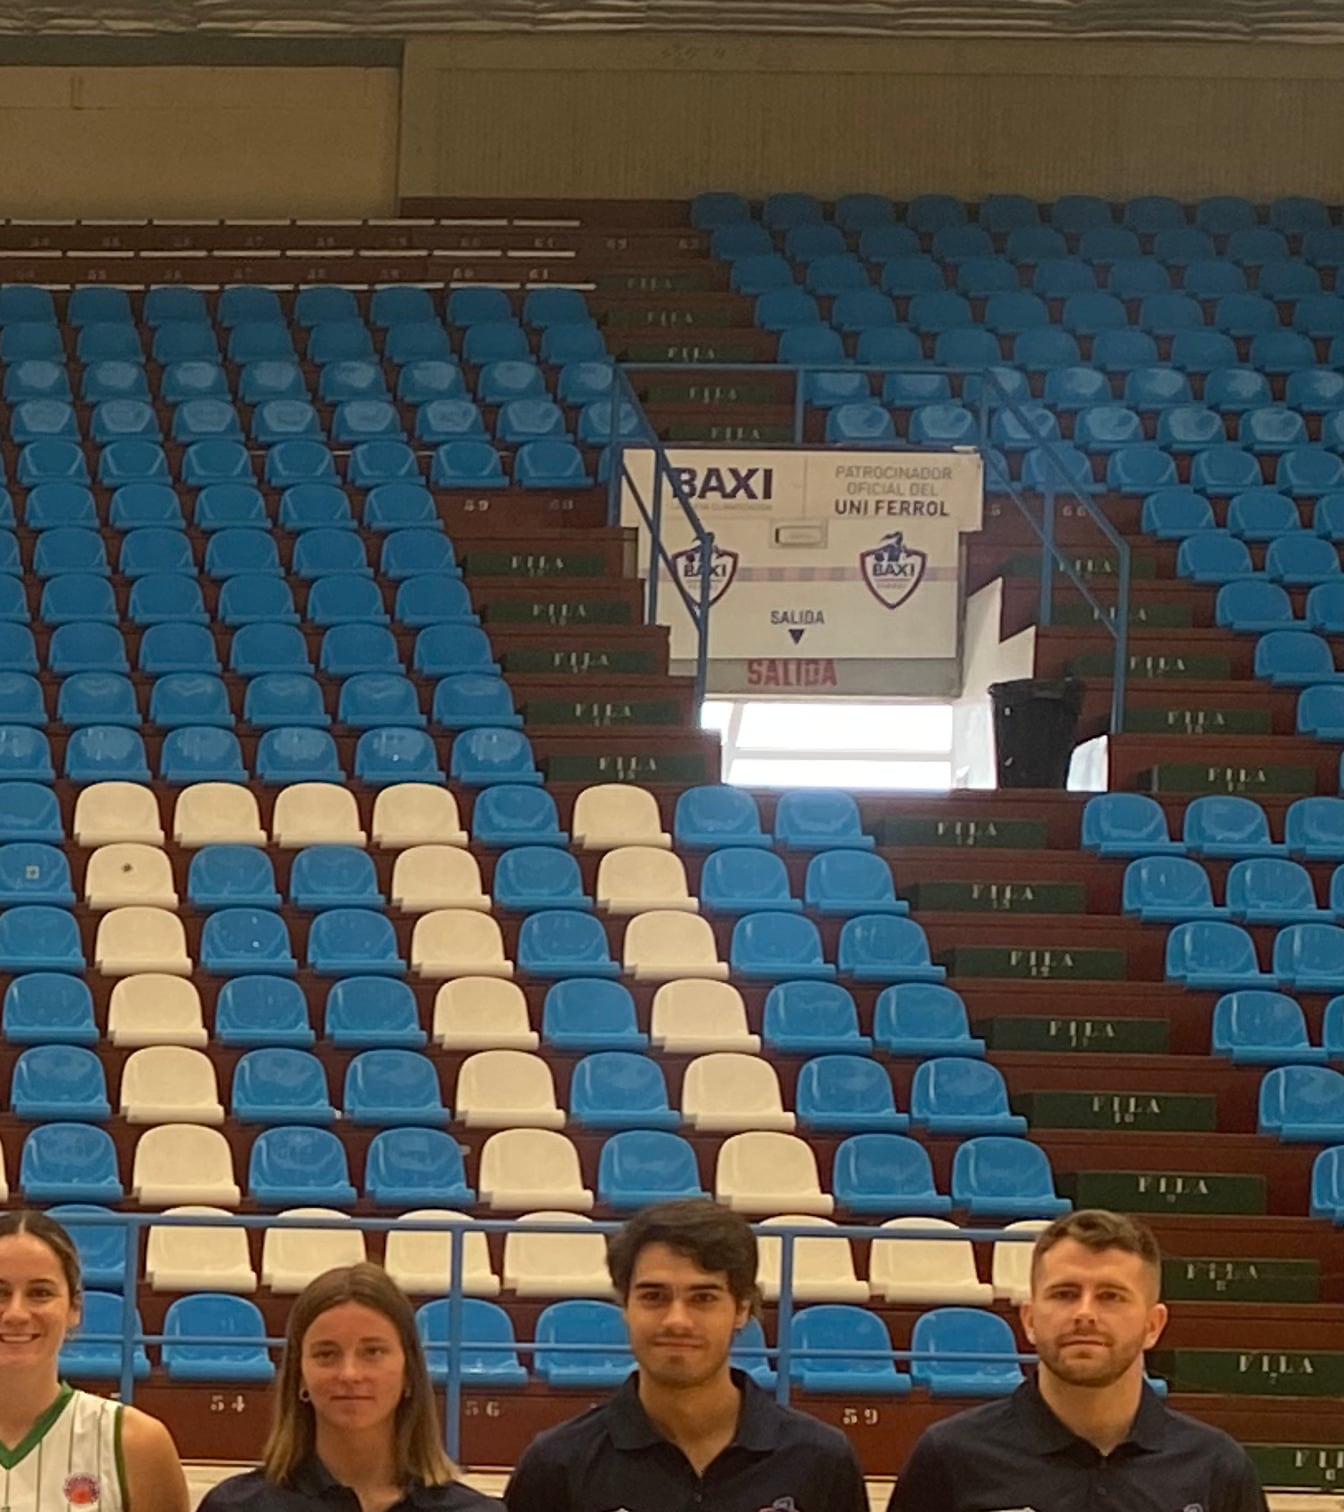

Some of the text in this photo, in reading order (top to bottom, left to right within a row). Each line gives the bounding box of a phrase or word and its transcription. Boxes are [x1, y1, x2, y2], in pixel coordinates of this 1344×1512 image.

[835, 464, 953, 481] PATROCINADOR
[673, 467, 774, 500] BAXI
[846, 480, 939, 498] OFICIAL DEL
[834, 499, 950, 517] UNI FERROL
[512, 556, 564, 568] FILA
[873, 563, 915, 577] BAXI
[532, 604, 586, 616] FILA
[771, 610, 825, 625] SALIDA
[554, 652, 609, 665] FILA
[1130, 657, 1185, 670] FILA
[747, 659, 838, 687] SALIDA
[575, 704, 632, 717] FILA
[1168, 711, 1224, 725] FILA
[599, 757, 657, 770] FILA
[1208, 768, 1266, 782] FILA
[937, 821, 998, 836] FILA
[972, 885, 1034, 899] FILA
[1011, 951, 1074, 966] FILA
[1050, 1021, 1117, 1037] FILA
[1093, 1096, 1160, 1113] FILA
[1139, 1177, 1209, 1193] FILA
[1240, 1355, 1314, 1373] FILA
[210, 1394, 245, 1411] 54
[465, 1400, 500, 1417] 56
[843, 1408, 878, 1424] 59
